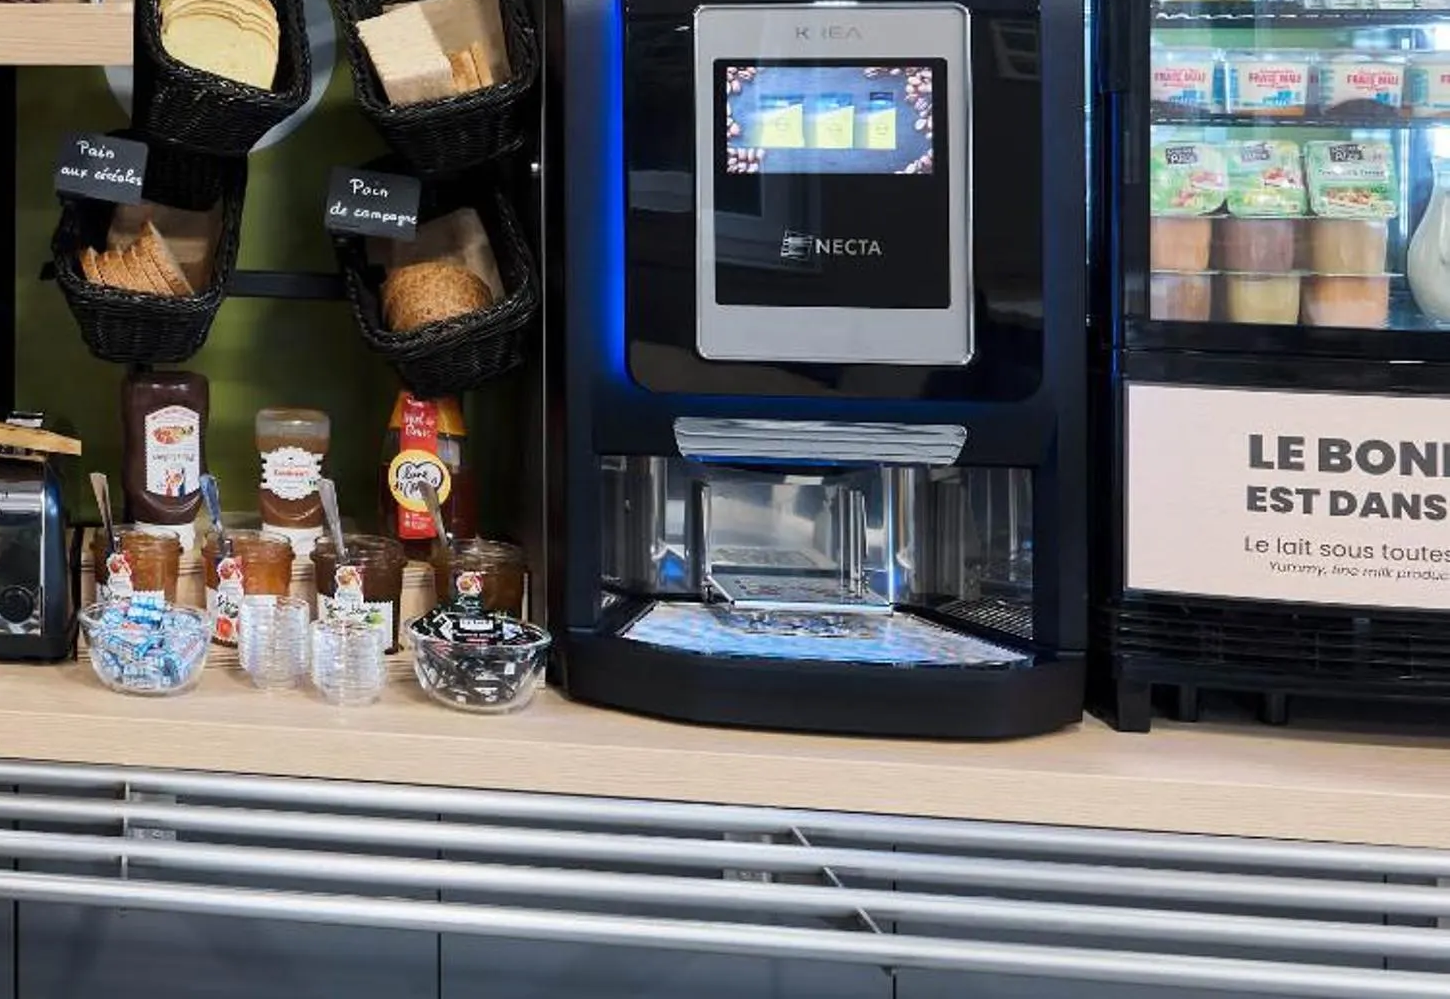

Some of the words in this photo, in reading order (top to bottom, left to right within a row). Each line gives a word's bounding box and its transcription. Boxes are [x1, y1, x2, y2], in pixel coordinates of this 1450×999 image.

[76, 140, 115, 159] Pain
[60, 166, 88, 178] aux
[349, 178, 389, 198] Pain
[330, 201, 347, 216] de
[815, 238, 882, 256] NECTA
[1248, 433, 1306, 472] LE
[1317, 437, 1450, 478] BON
[1246, 485, 1321, 516] EST
[1329, 489, 1447, 521] DANS
[1244, 535, 1269, 554] Le
[1276, 537, 1311, 557] lait
[1319, 541, 1374, 560] sous
